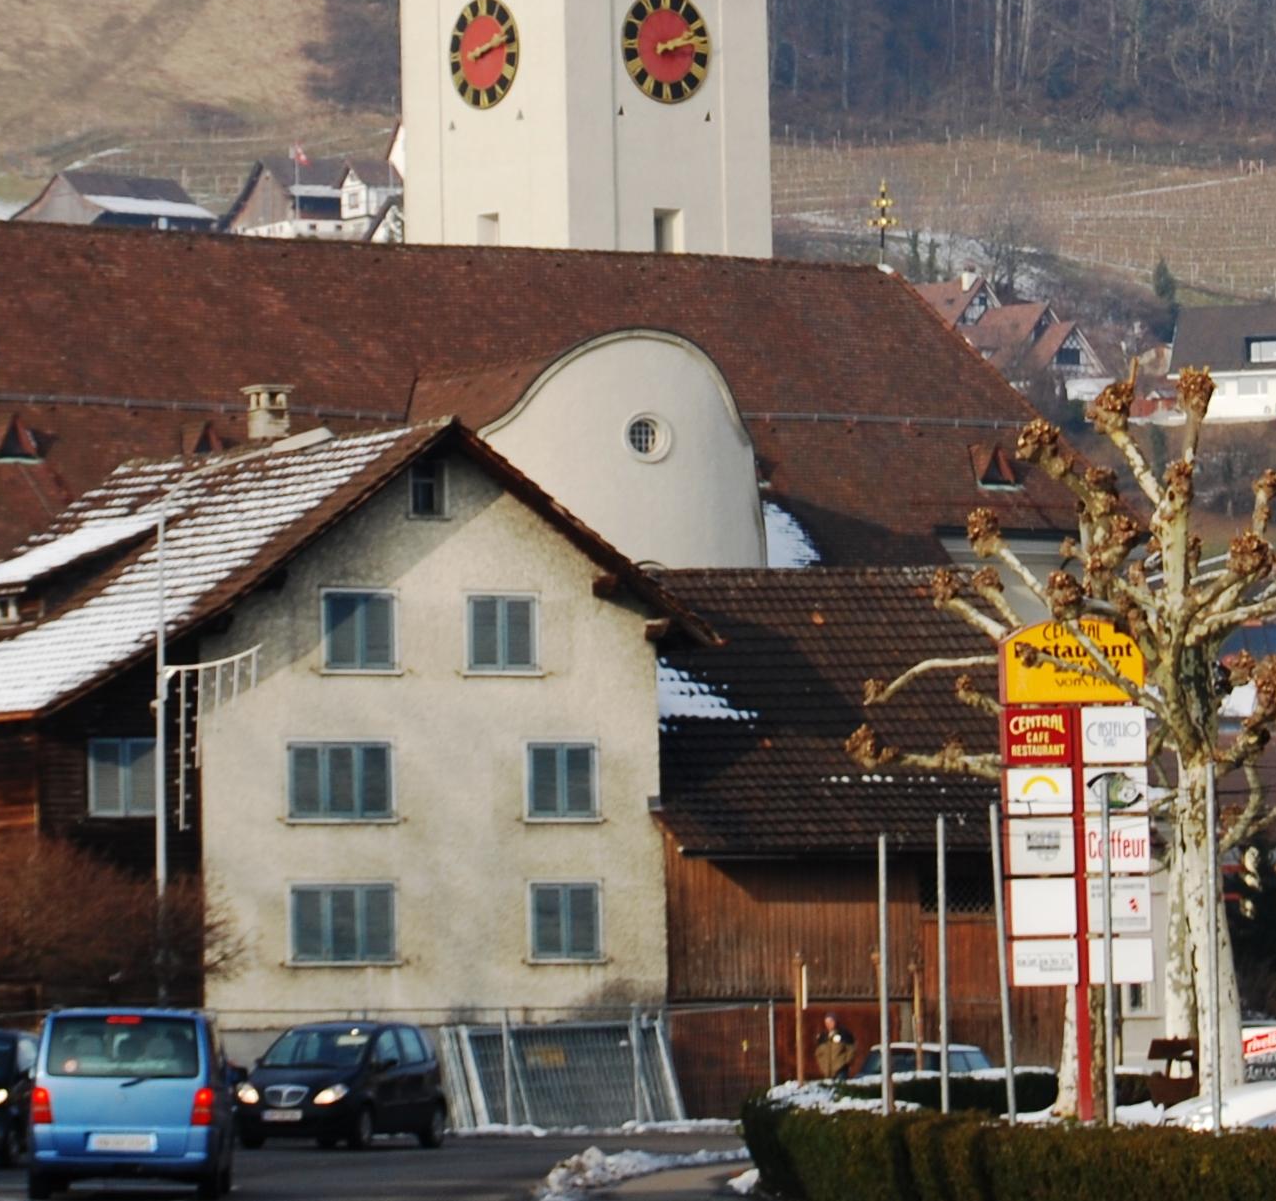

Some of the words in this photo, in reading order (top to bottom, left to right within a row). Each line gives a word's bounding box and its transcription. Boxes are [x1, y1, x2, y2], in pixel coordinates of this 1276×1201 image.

[1009, 714, 1066, 736] CENTRAL
[1011, 744, 1066, 757] RESTAURANT
[1088, 830, 1147, 859] Coffeur
